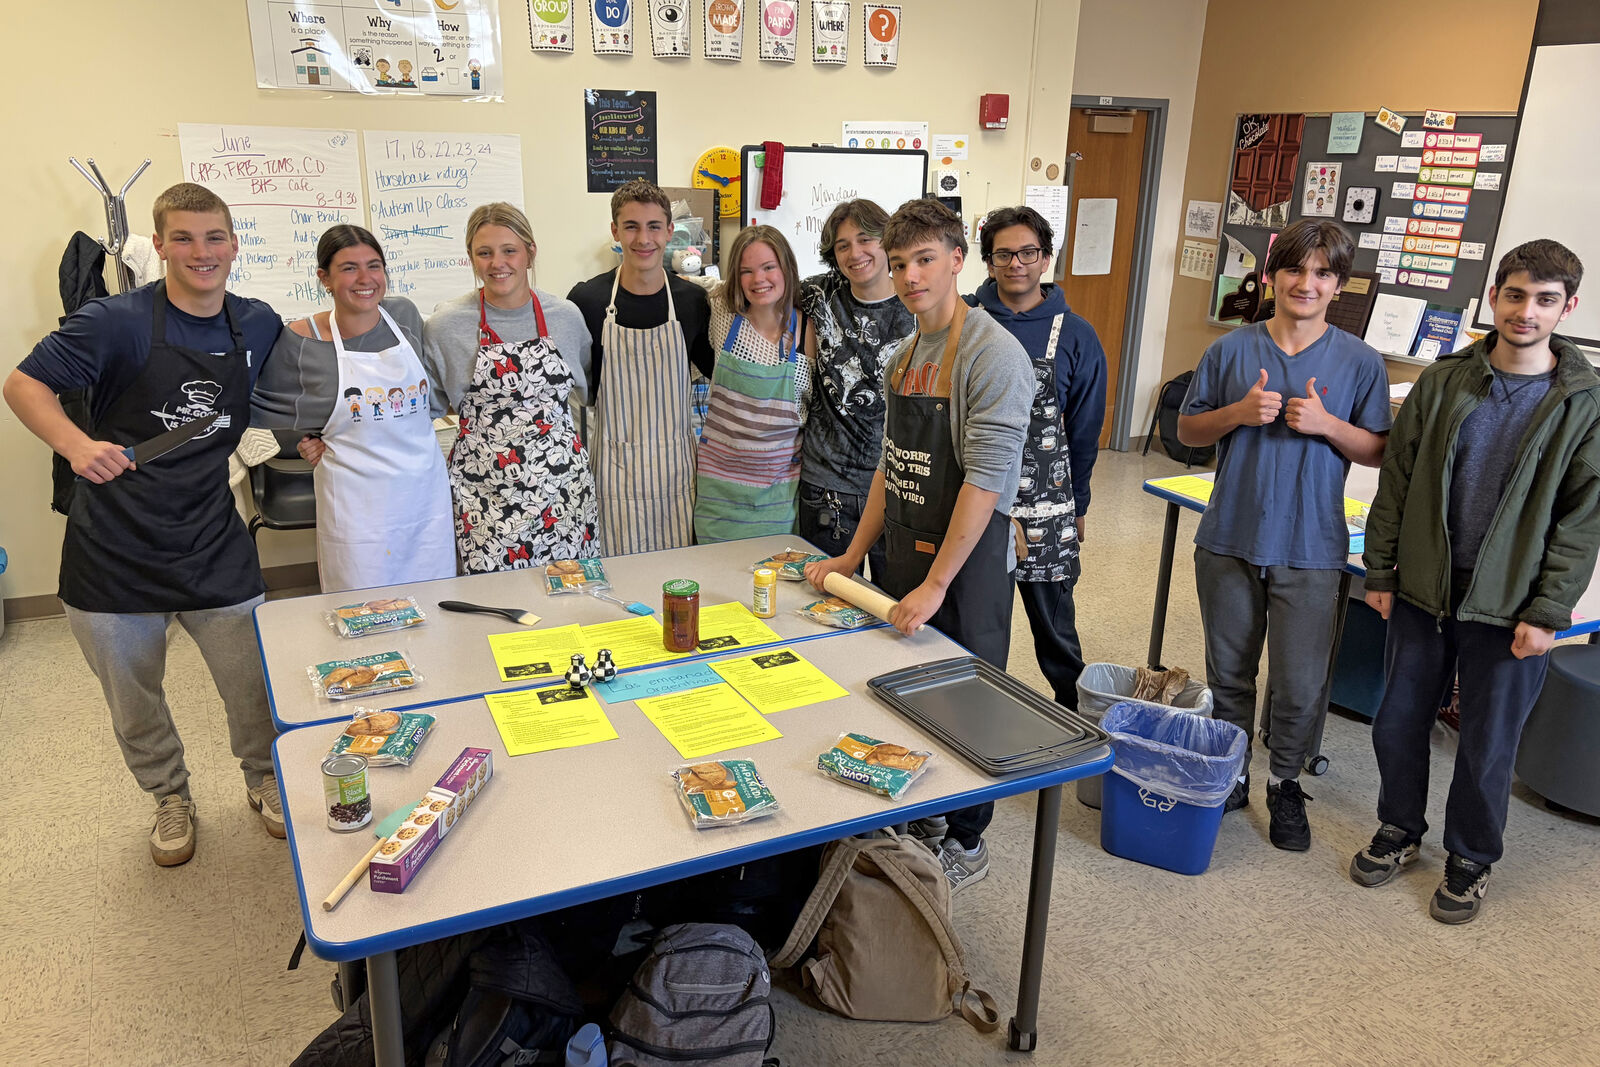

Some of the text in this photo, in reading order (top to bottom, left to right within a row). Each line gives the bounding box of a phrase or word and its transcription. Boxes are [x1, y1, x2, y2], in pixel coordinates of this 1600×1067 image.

[534, 0, 568, 14] GROUP
[606, 6, 620, 19] DO
[288, 11, 326, 24] Where
[366, 16, 392, 31] Why
[712, 14, 738, 27] MADE
[768, 16, 791, 30] PARTS
[304, 28, 326, 38] place
[437, 20, 460, 32] How
[819, 20, 845, 32] WHERE
[433, 48, 444, 62] 2
[599, 98, 610, 108] This
[1242, 116, 1258, 134] OK
[1425, 118, 1444, 126] BRAVE
[212, 128, 251, 154] June
[1239, 121, 1269, 150] Chocolate
[477, 144, 492, 154] 24
[251, 178, 314, 194] BHS Cafe
[376, 170, 432, 190] Horseback
[812, 183, 858, 207] Monday
[378, 192, 468, 220] Autism Up Class
[290, 208, 313, 224] Char
[895, 448, 932, 465] WORRY,
[907, 463, 931, 477] THIS
[916, 482, 920, 492] A
[902, 491, 925, 505] VIDEO
[842, 770, 870, 784] GOYA
[345, 788, 362, 797] Black
